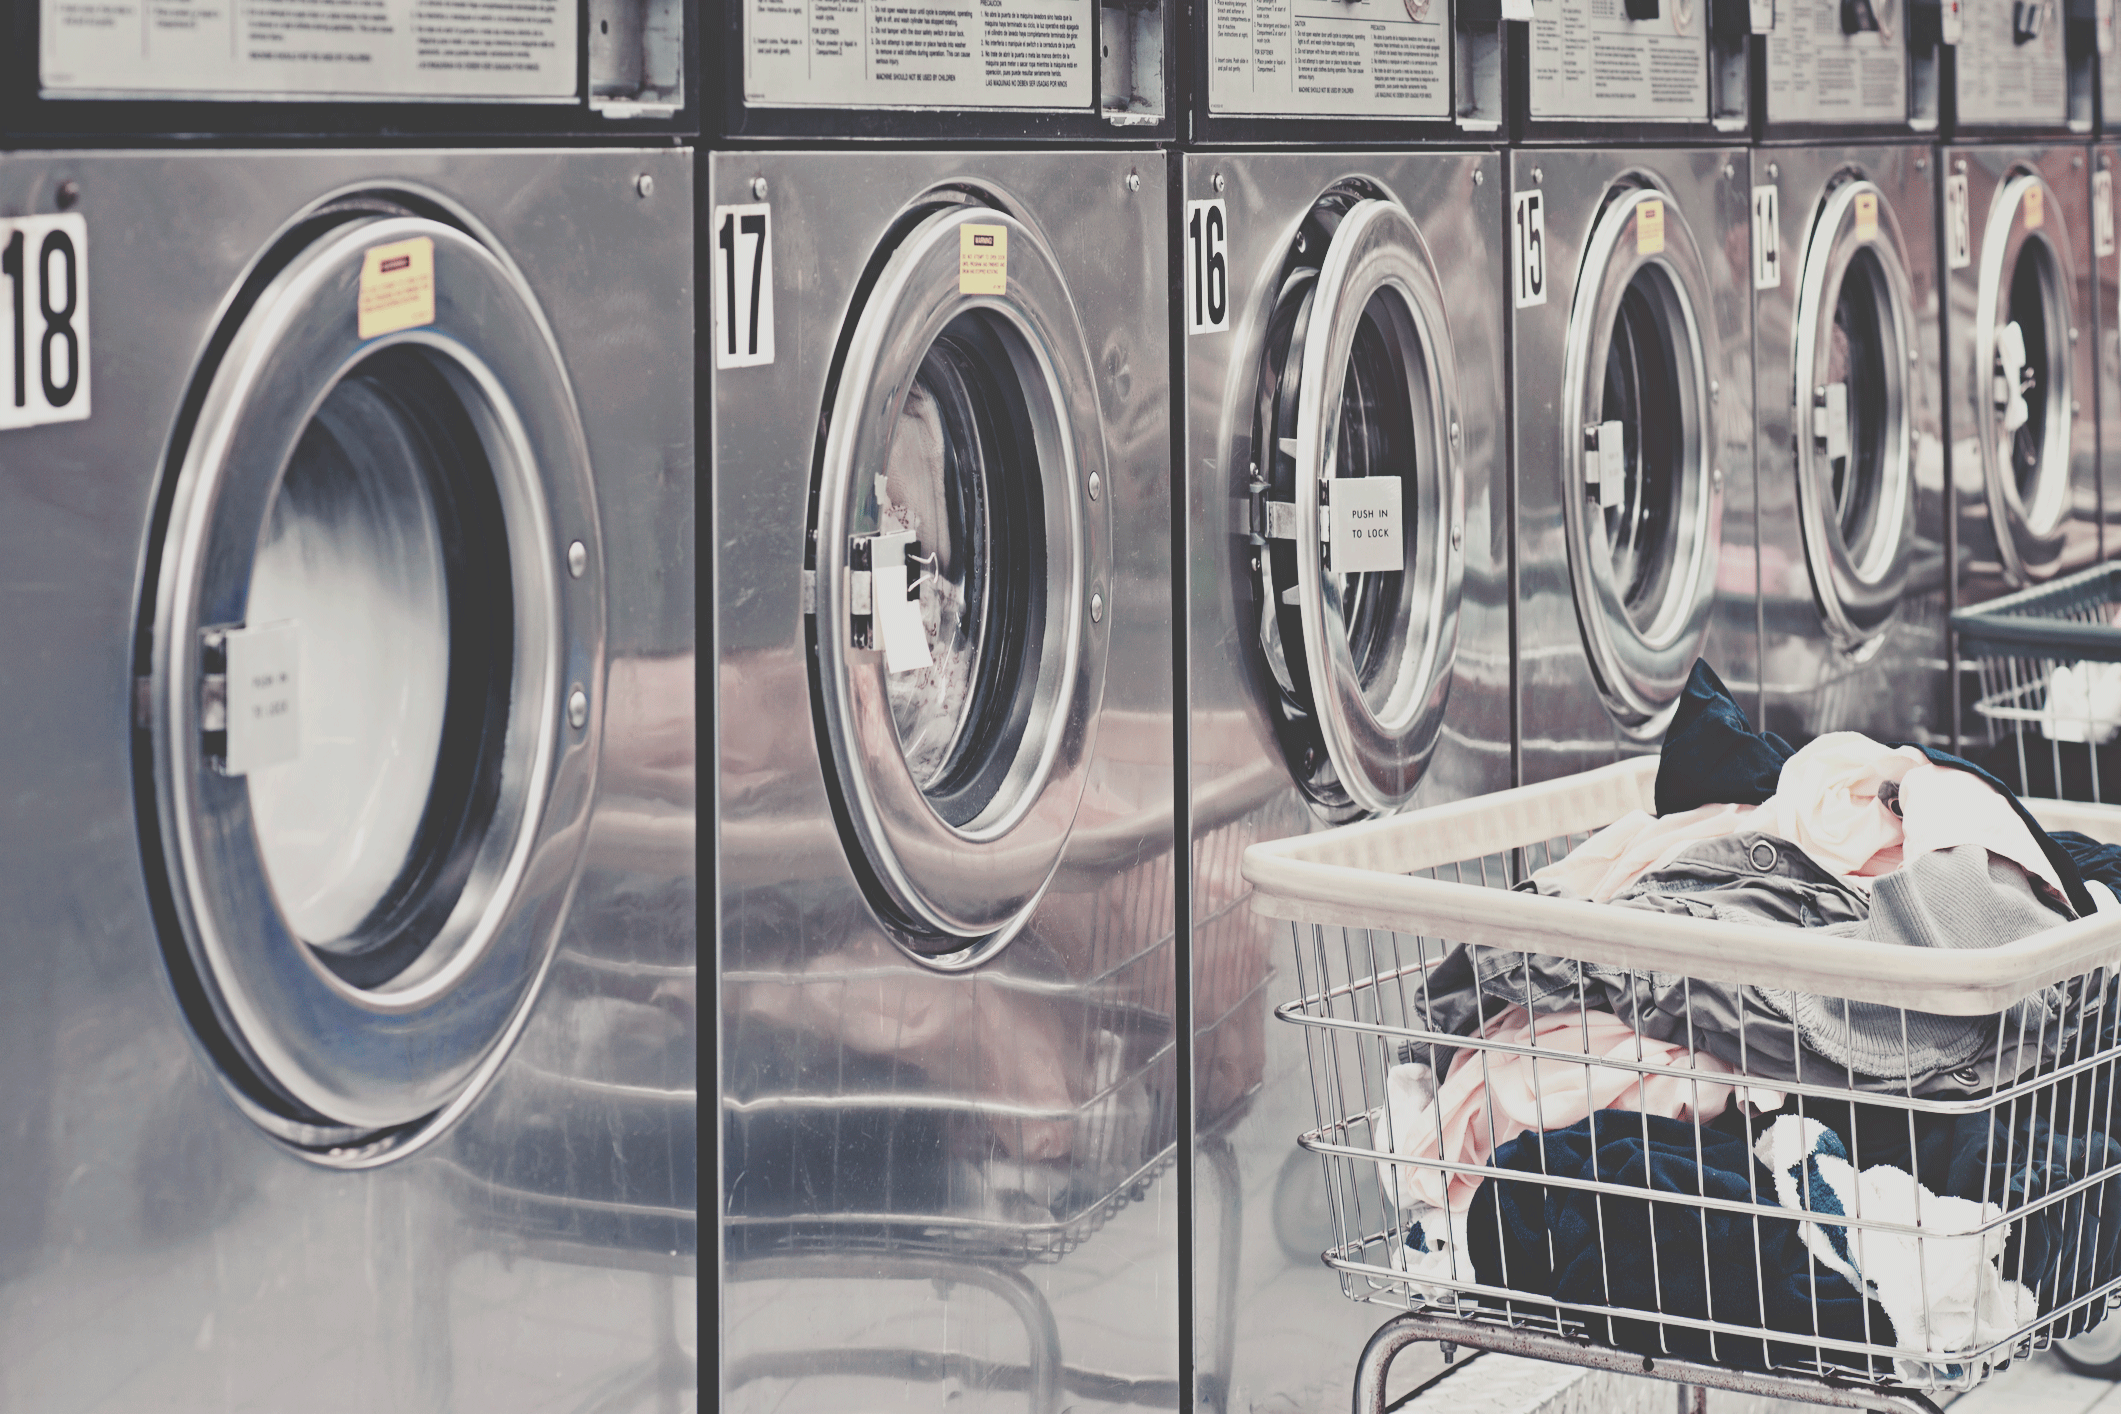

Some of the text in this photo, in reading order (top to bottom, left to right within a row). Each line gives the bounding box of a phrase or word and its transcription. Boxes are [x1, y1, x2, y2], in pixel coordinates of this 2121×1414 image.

[719, 213, 766, 355] 17
[1189, 205, 1226, 325] 16
[1517, 196, 1542, 299] 15
[2, 229, 78, 407] 18
[1352, 509, 1388, 519] PUSH IN
[1352, 529, 1389, 538] TO LOCK
